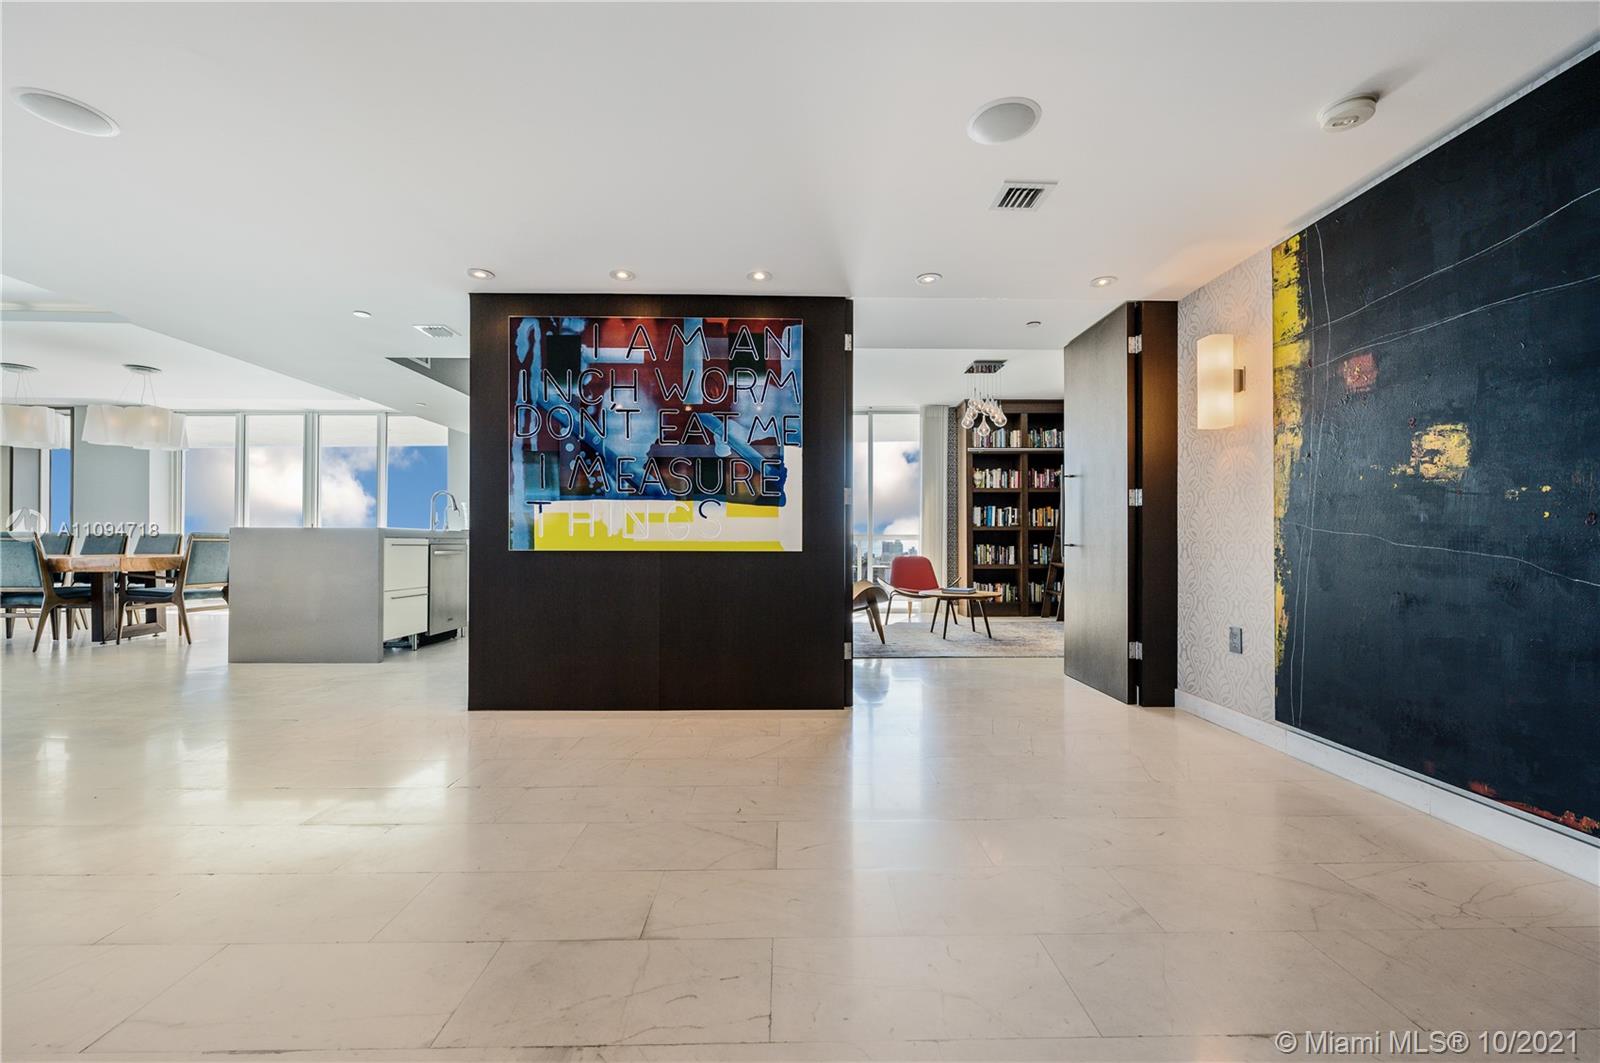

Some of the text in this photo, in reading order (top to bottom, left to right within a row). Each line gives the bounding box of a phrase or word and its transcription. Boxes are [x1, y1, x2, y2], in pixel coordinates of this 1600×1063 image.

[592, 323, 793, 362] I AM AN
[519, 367, 801, 405] INCH WORM
[514, 403, 801, 448] DON'T EAT ME
[538, 453, 783, 496] I MEASURE
[526, 498, 721, 538] THINGS
